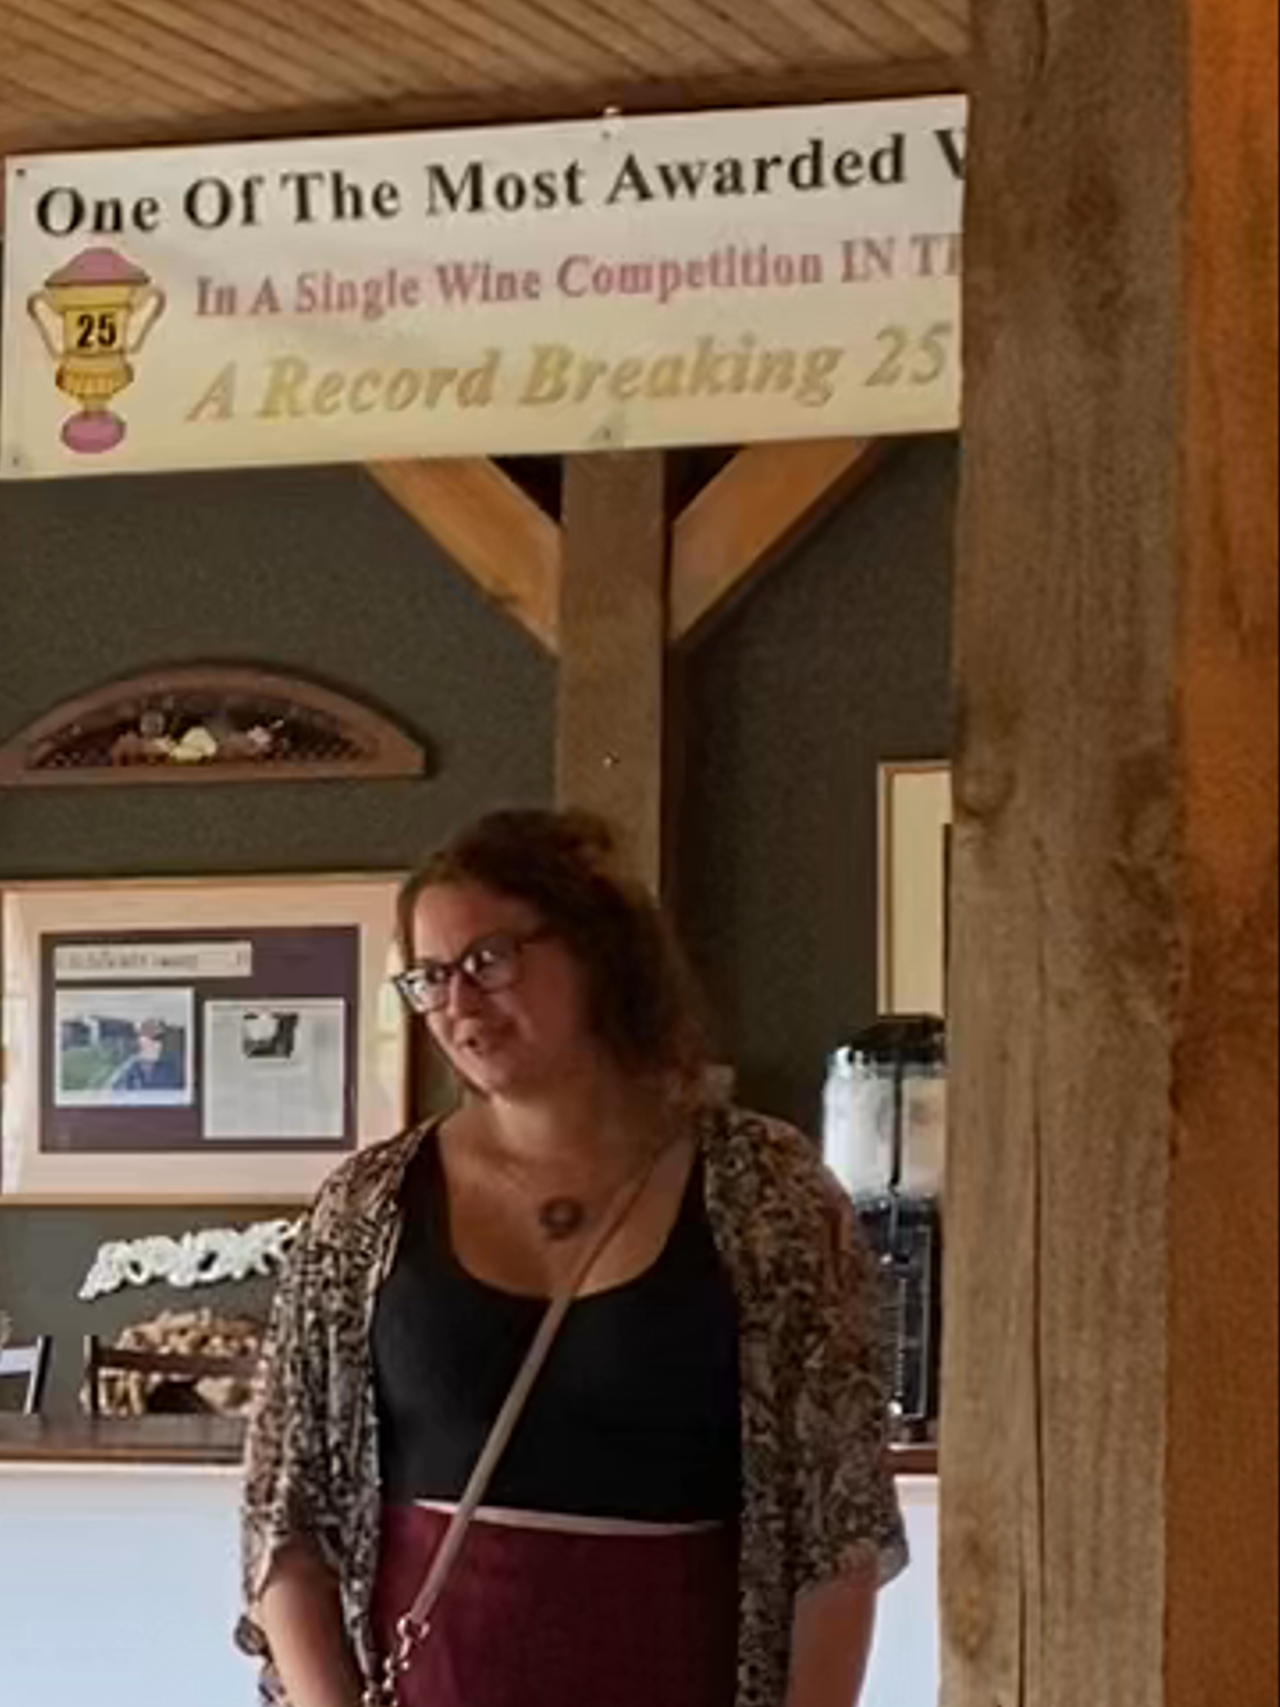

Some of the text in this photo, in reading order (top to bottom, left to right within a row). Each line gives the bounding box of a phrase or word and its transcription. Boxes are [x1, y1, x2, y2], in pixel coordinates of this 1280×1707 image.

[36, 186, 161, 238] One
[183, 175, 264, 229] Of
[280, 170, 401, 224] The
[425, 160, 584, 215] Most
[605, 132, 906, 206] Awarded
[195, 275, 238, 317] In
[249, 276, 283, 316] A
[296, 267, 420, 322] Single
[434, 261, 542, 305] Wine
[555, 243, 824, 305] Competition
[840, 235, 896, 284] IN
[76, 313, 117, 348] 25
[185, 321, 953, 423] A Record Breaking 25
